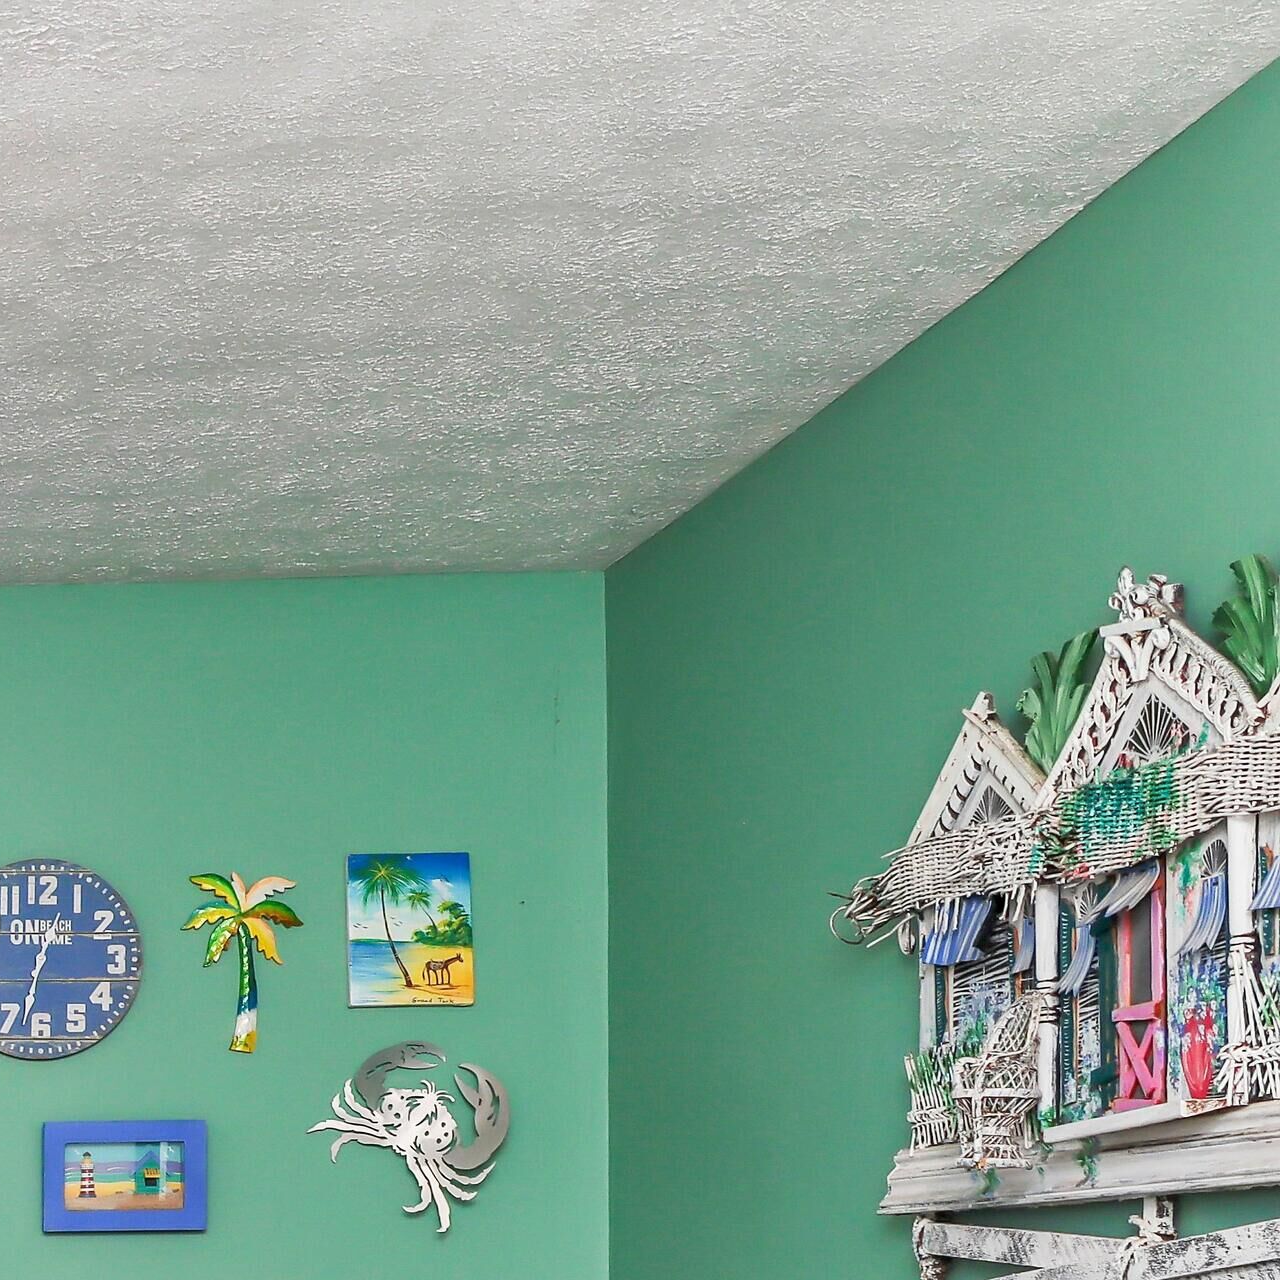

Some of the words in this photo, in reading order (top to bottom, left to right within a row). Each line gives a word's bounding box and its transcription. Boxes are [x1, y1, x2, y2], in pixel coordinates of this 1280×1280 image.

[0, 885, 20, 916] 11
[27, 875, 58, 905] 12
[73, 884, 82, 914] 1
[10, 919, 40, 945] ON
[39, 933, 73, 945] TME
[93, 910, 115, 940] 2
[107, 944, 126, 975] 3
[89, 981, 113, 1011] 4
[0, 1003, 21, 1034] 7
[30, 1012, 52, 1043] 6
[66, 1003, 87, 1033] 5
